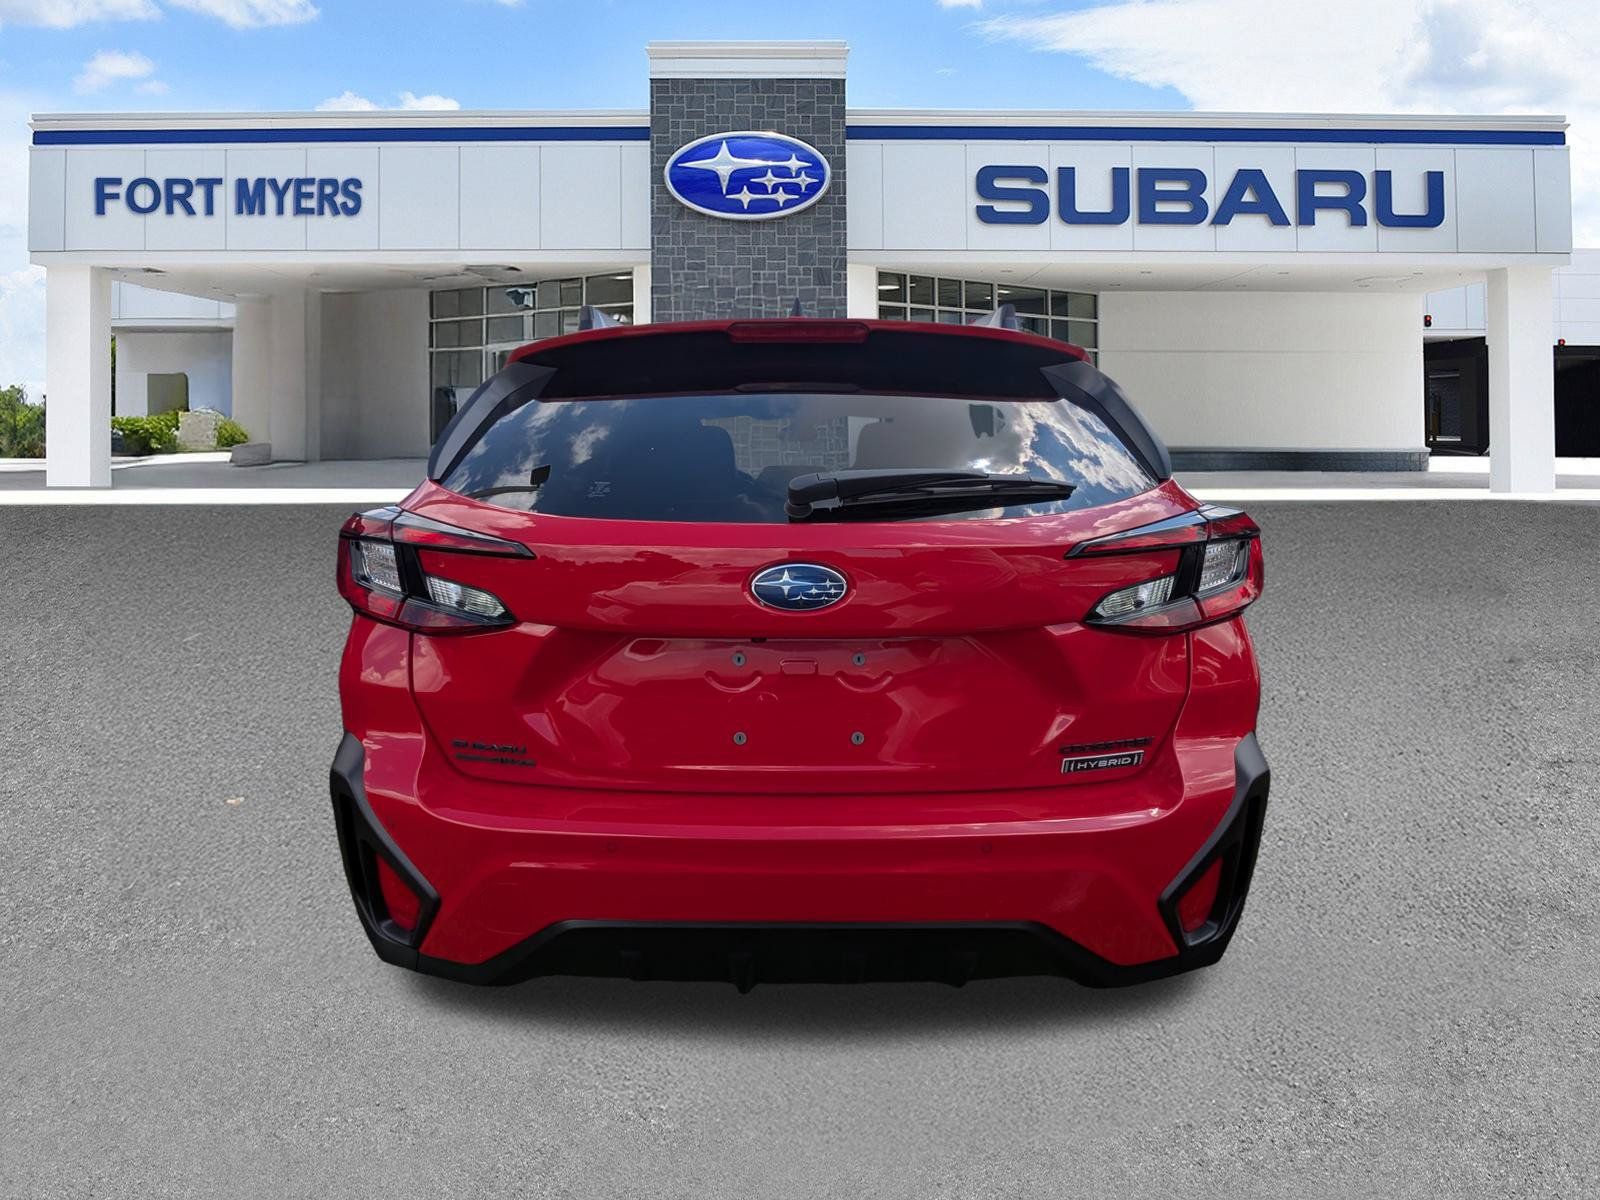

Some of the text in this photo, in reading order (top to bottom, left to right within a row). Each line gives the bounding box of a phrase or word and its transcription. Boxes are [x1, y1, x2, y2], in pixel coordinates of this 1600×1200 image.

[94, 177, 363, 217] FORT MYERS
[975, 165, 1446, 228] SUBARU
[1077, 757, 1132, 770] HYBRID
